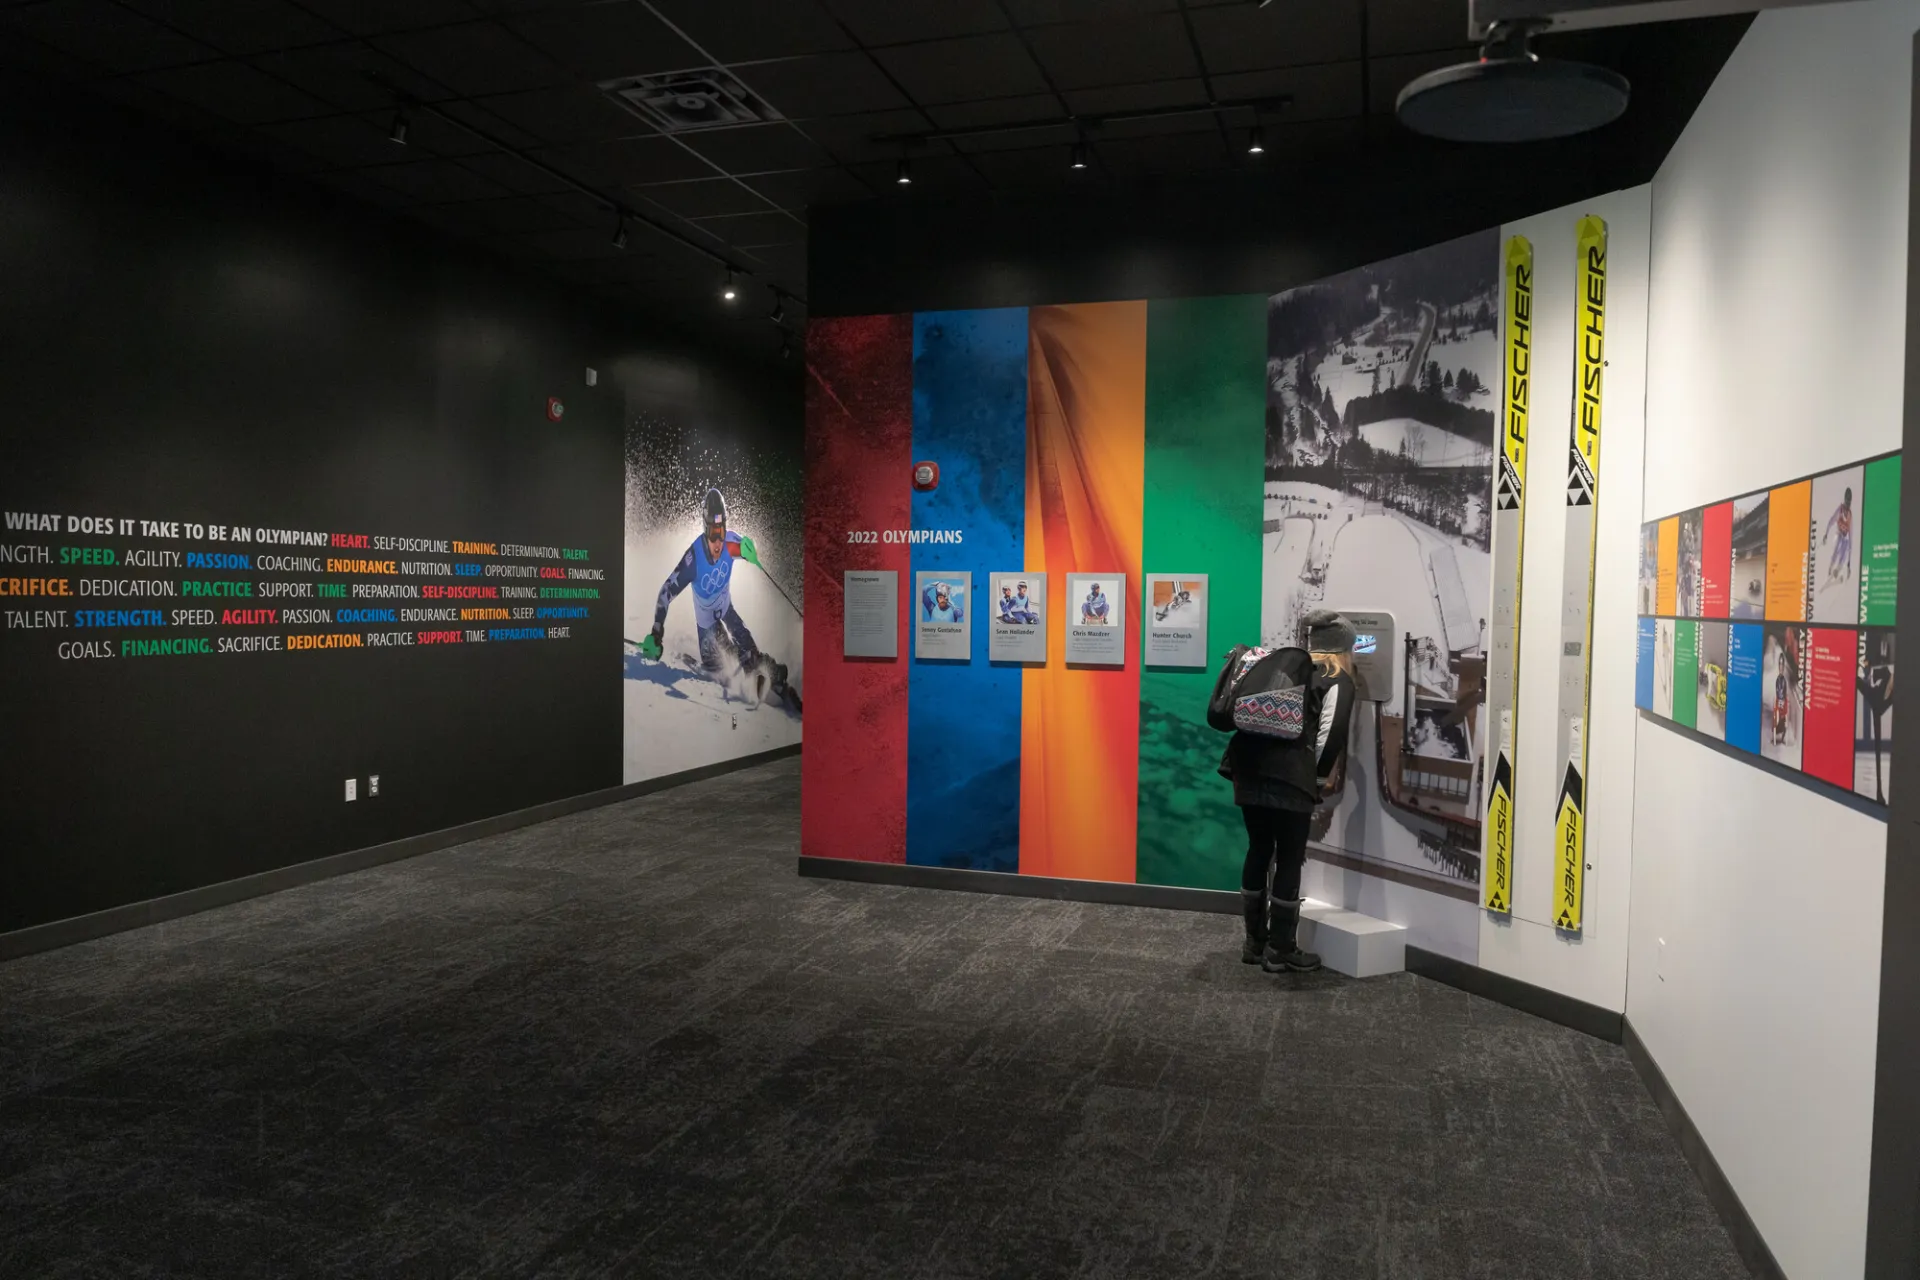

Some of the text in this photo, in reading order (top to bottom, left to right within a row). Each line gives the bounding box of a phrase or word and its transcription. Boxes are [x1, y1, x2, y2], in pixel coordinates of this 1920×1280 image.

[1511, 264, 1530, 443] FISCHER
[1582, 246, 1605, 435] FISCHER
[1500, 455, 1521, 490] FISCHER
[1571, 448, 1594, 484] FISCHER
[4, 512, 589, 560] WHAT DOES IT TAKE TO BE AN OLYMPIAN? HEART. SELF-DISCIPLINE. TRAINING. DETERMINATION. TALENT.
[847, 530, 963, 544] 2022 OLYMPIANS
[60, 548, 120, 565] SPEED.
[125, 550, 182, 568] AGILITY.
[186, 552, 252, 570] PASSION.
[257, 555, 323, 572] COACHING.
[326, 559, 398, 574] ENDURANCE.
[401, 562, 452, 576] NUTRITION.
[455, 565, 483, 576] SLEEP.
[485, 566, 538, 578] OPPORTUNITY.
[540, 568, 566, 578] GOALS.
[568, 569, 606, 580] FINANCING.
[80, 580, 178, 596] DEDICATION.
[182, 582, 254, 597] PRACTICE.
[258, 582, 314, 598] SUPPORT.
[318, 584, 348, 598] TIME.
[352, 585, 420, 598] PREPARATION.
[422, 586, 499, 598] SELF-DISCIPLINE.
[501, 587, 538, 598] TRAINING.
[540, 588, 600, 598] DETERMINATION.
[5, 608, 590, 628] TALENT. STRENGTH. SPEED. AGILITY. PASSION. COACHING. ENDURANCE. NUTRITION. SLEEP. OPPORTUNITY.
[1804, 520, 1817, 710] ANDREW WEIBRECHT
[1857, 565, 1869, 678] PAUL WYLIE
[58, 627, 570, 659] GOALS. FINANCING. SACRIFICE. DEDICATION. PRACTICE. SUPPORT. TIME. PREPARATION. HEART.
[1496, 793, 1507, 889] FISCHER
[1564, 806, 1576, 907] FISCHER
